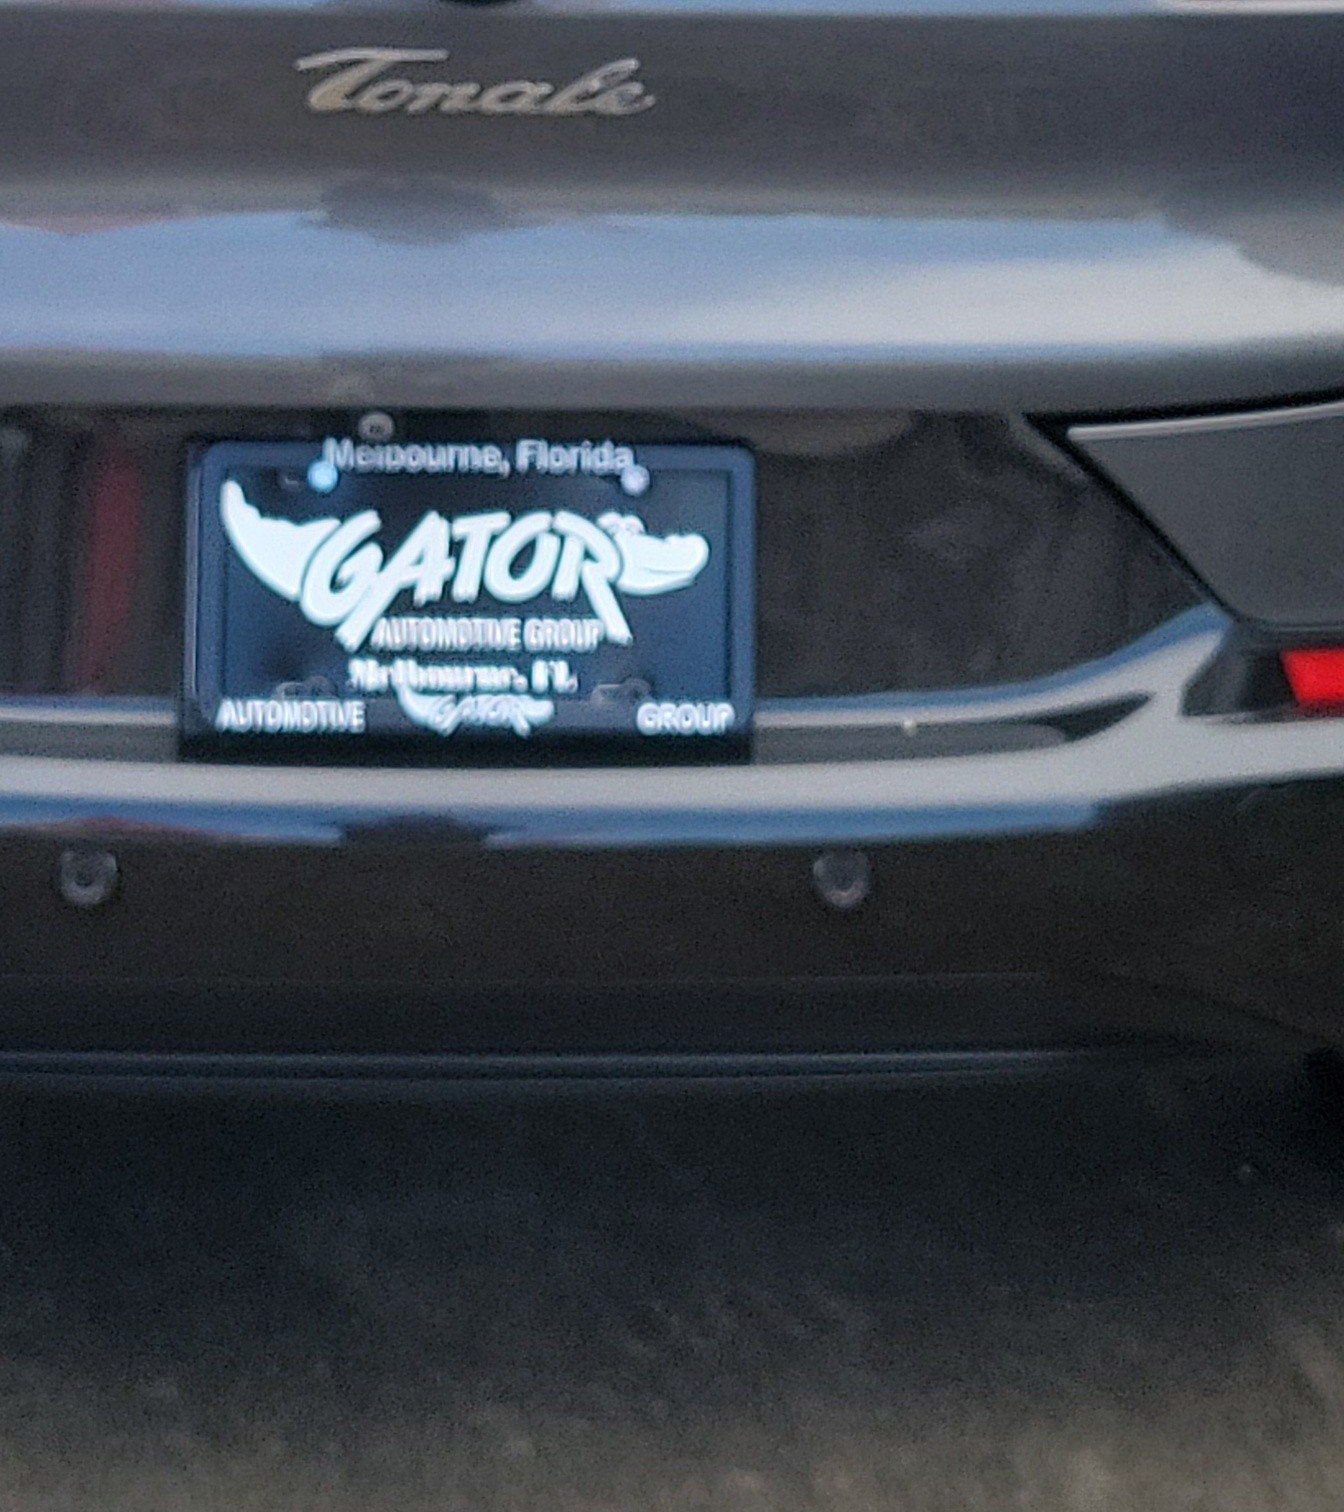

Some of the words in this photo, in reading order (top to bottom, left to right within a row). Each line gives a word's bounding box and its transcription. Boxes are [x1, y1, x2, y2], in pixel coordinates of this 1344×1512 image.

[293, 46, 657, 116] Tonale
[515, 439, 636, 475] Florida
[299, 508, 634, 650] GATOR
[370, 616, 521, 652] AUTOMOTIVE
[523, 616, 604, 650] GROUP
[215, 698, 366, 734] AUTOMOTIVE
[636, 700, 736, 736] GROUP
